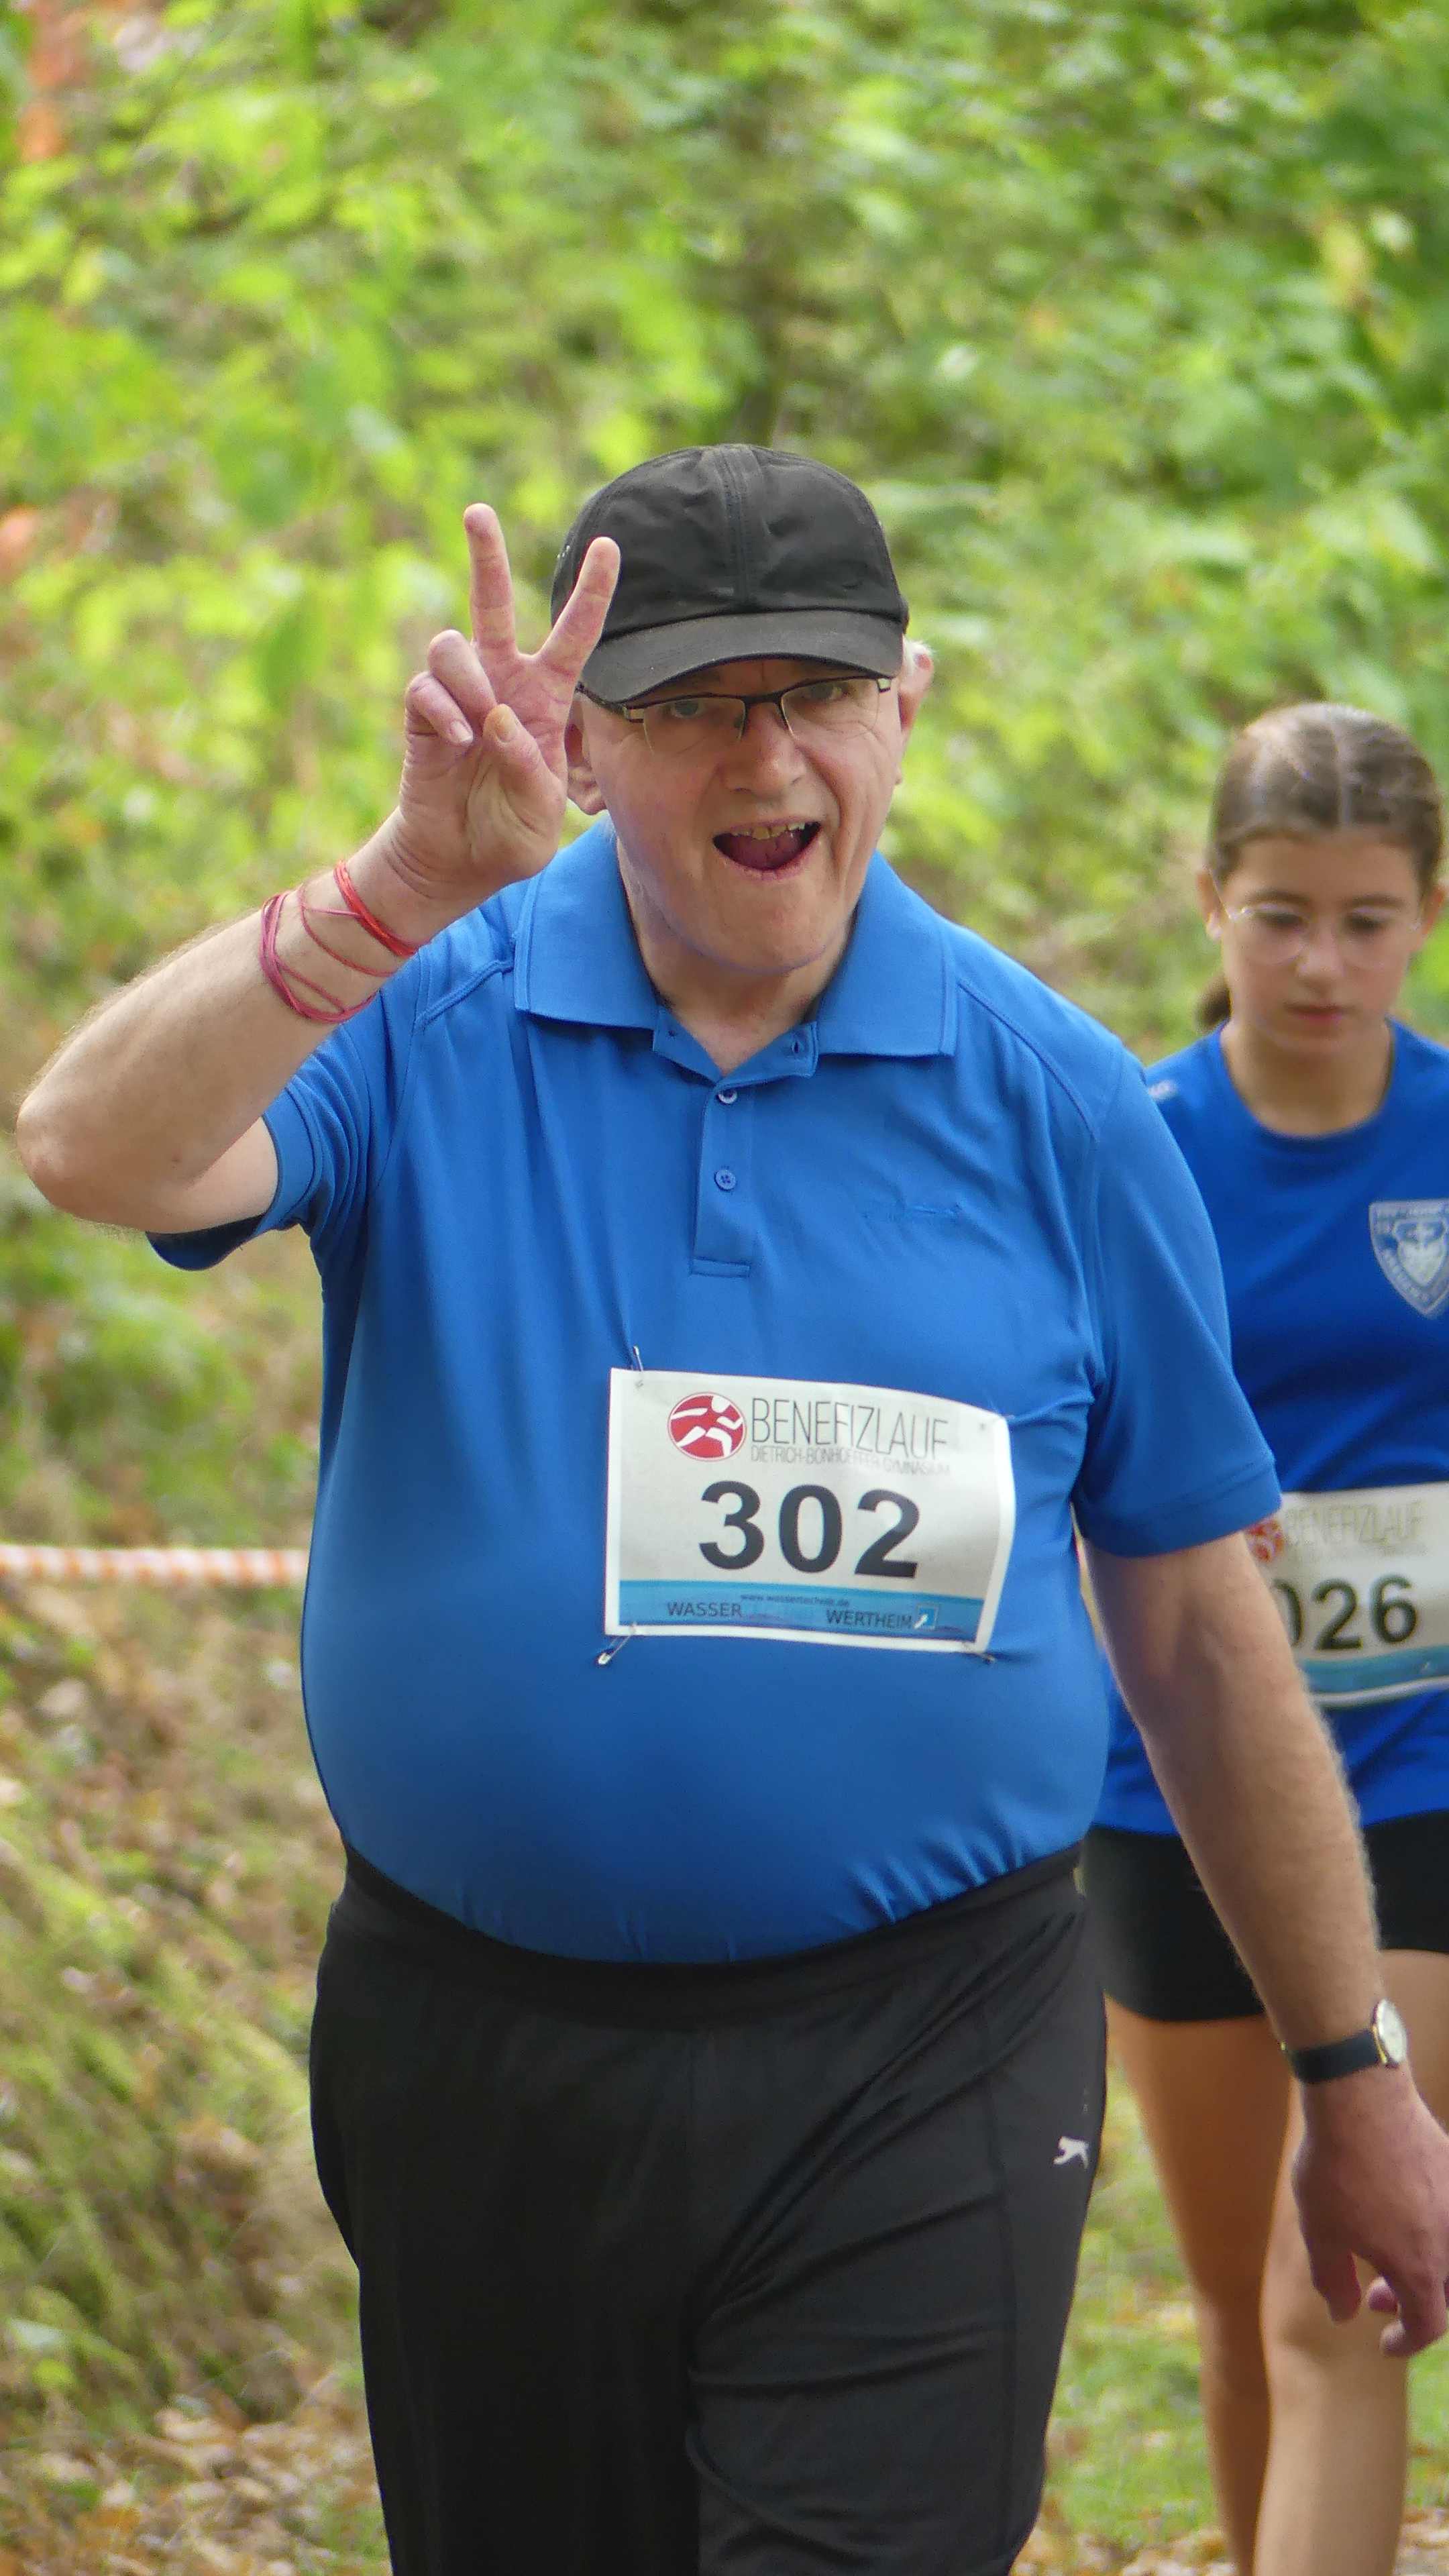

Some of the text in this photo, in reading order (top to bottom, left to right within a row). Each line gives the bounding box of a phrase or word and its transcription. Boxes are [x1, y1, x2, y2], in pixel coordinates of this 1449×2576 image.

[751, 1397, 949, 1460] BENEFIZLAUF
[698, 1481, 920, 1578] 302
[667, 1602, 743, 1617] WASSER
[826, 1609, 912, 1629] WERTHEIM
